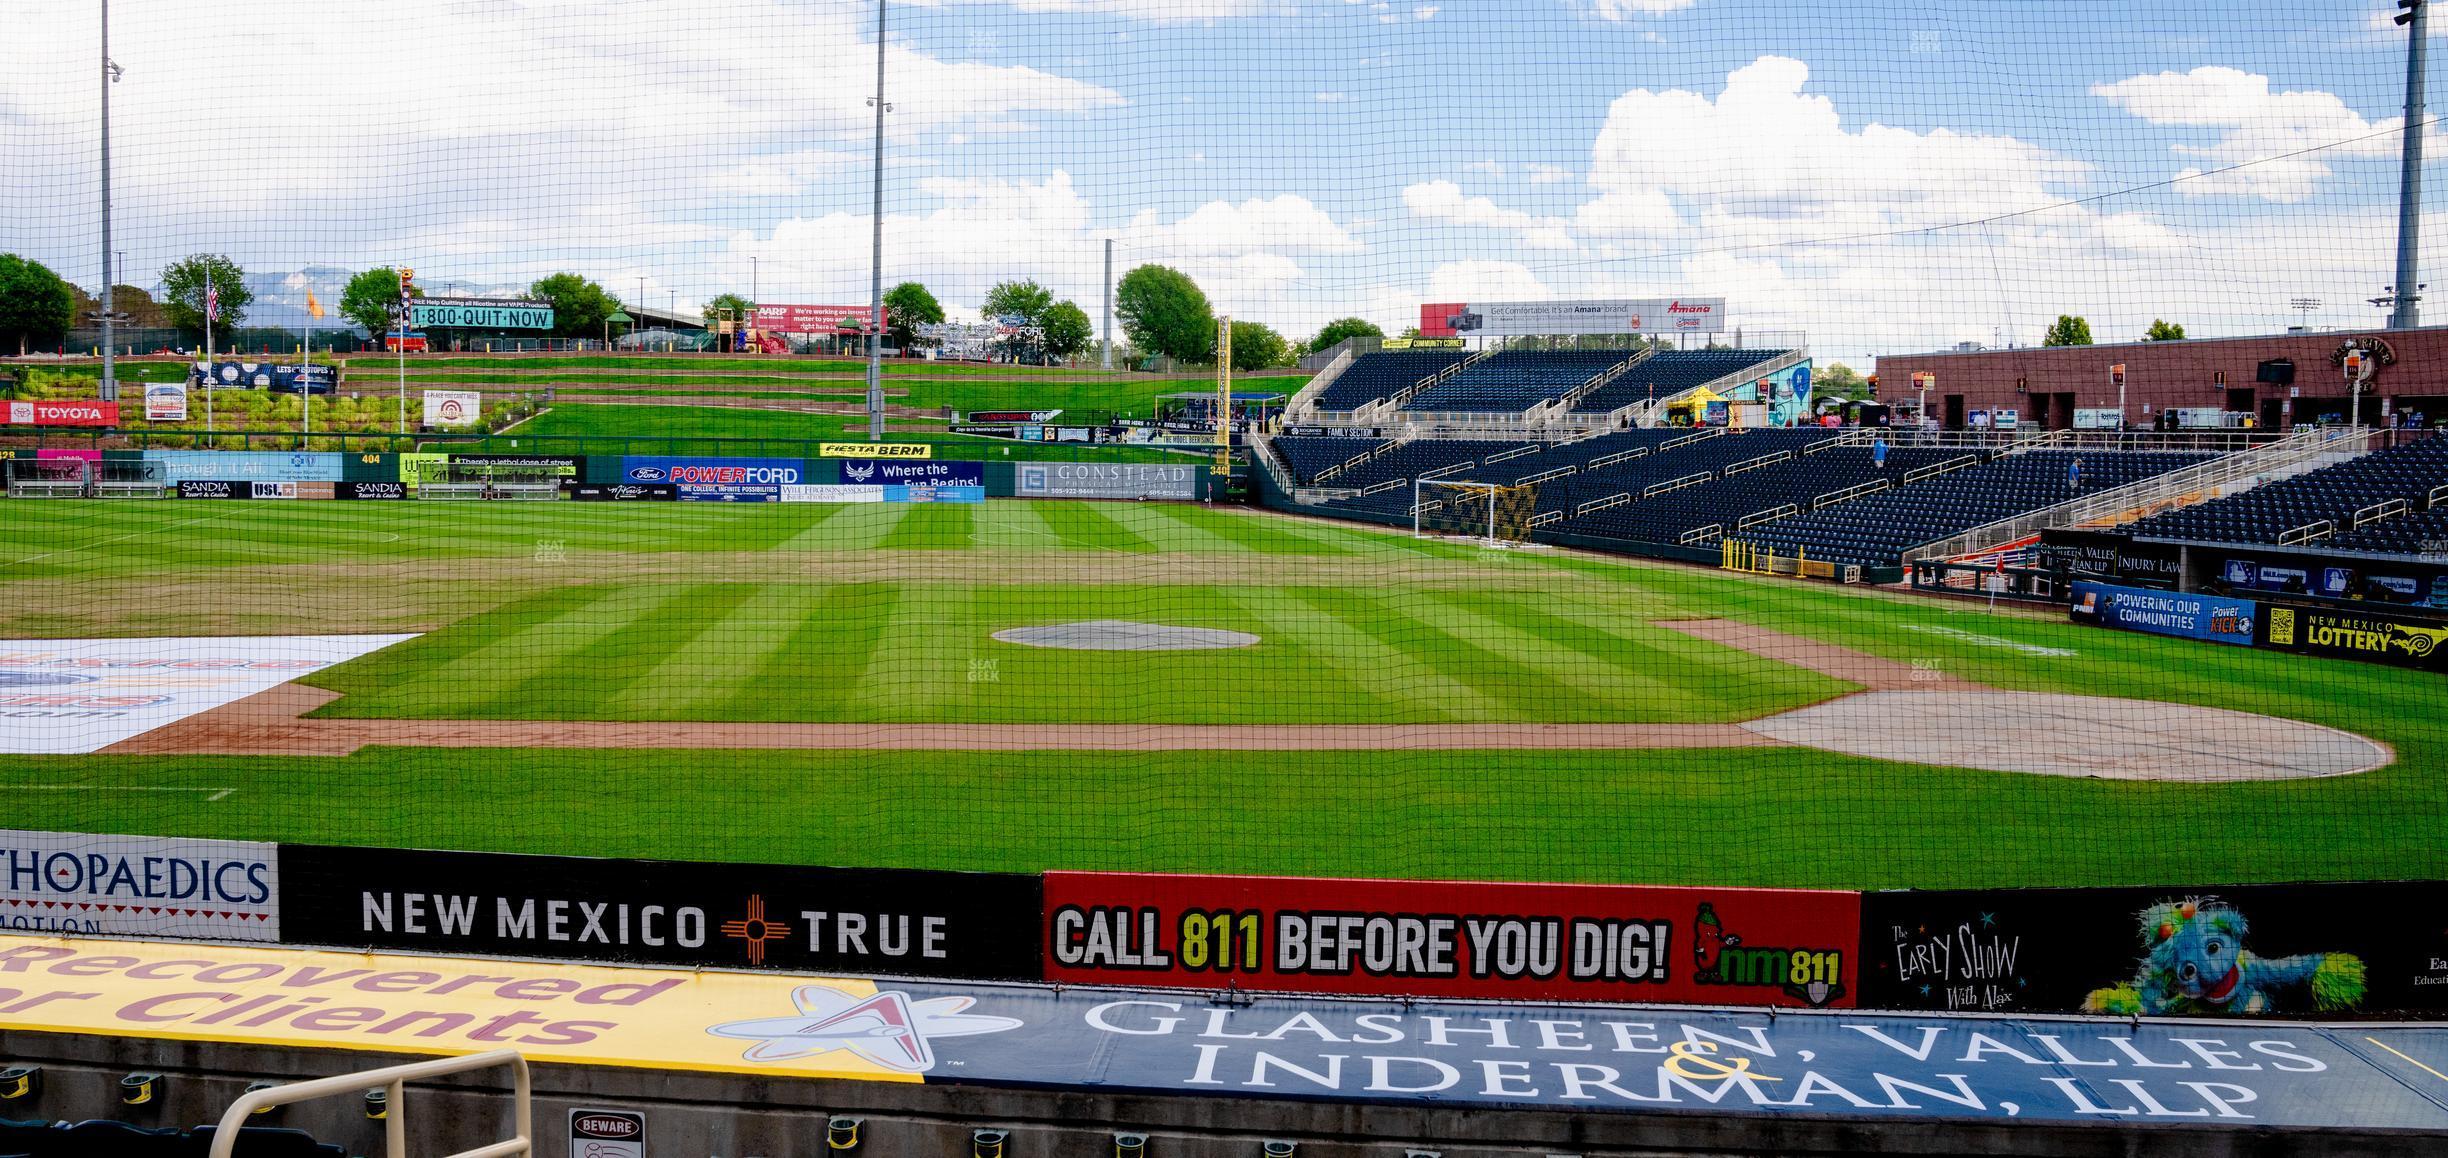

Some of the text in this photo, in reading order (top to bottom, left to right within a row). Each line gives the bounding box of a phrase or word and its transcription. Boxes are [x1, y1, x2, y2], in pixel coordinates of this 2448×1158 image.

[813, 308, 838, 316] working
[1668, 301, 1711, 314] Amana
[800, 323, 815, 331] right
[1413, 339, 1442, 347] COMMUNITY
[1443, 339, 1464, 347] CORNER
[38, 407, 101, 419] TOYOTA
[1327, 427, 1349, 437] FAMILY
[1349, 427, 1374, 437] SECTION
[825, 445, 925, 455] FIESTA BERM
[362, 454, 380, 464] 404
[637, 469, 659, 479] Ford
[882, 463, 948, 477] Where the
[1058, 465, 1185, 481] GONSTEAD
[1210, 466, 1227, 475] 340
[181, 482, 231, 492] SANDIA
[355, 483, 402, 493] SANDIA
[2086, 547, 2115, 560] VALLES
[2094, 561, 2108, 571] LLP
[2118, 555, 2156, 571] INJURY
[2073, 604, 2095, 614] PNM
[2177, 601, 2200, 615] OUR
[2212, 606, 2239, 618] Power
[2119, 608, 2194, 630] COMMUNITIES
[2210, 617, 2237, 633] KICK
[2310, 616, 2393, 633] NEW MEXICO
[2308, 626, 2392, 652] LOTTERY
[362, 891, 946, 958] NEW MEXICO TRUE
[1892, 925, 1908, 942] The
[1056, 909, 1667, 979] CALL 811 BEFORE YOU DIG!
[0, 945, 687, 1006] Recovered
[1946, 984, 1977, 1009] With
[115, 992, 619, 1045] Clients
[1085, 1001, 2327, 1072] GLASHEEN, VALLES
[1664, 1041, 1783, 1081] &
[1183, 1043, 2258, 1119] INDERMAN, LLP
[582, 1119, 632, 1133] BEWARE
